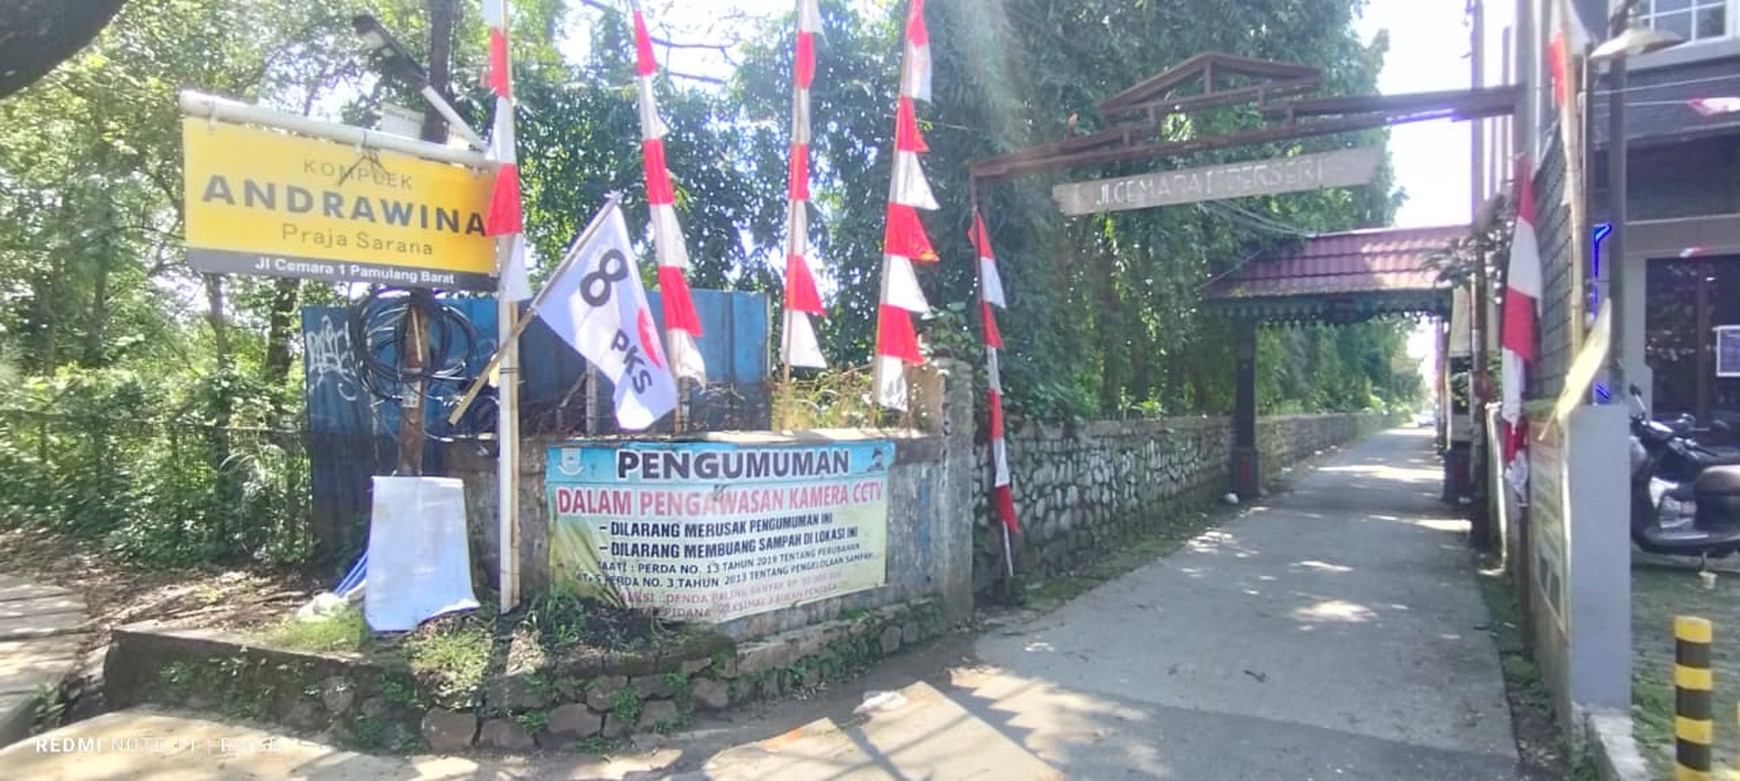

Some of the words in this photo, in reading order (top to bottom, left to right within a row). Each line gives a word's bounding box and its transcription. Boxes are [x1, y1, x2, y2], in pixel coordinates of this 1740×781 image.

[303, 158, 412, 191] KOMPLEK
[202, 174, 487, 237] ANDRAWINA
[282, 222, 348, 249] Praja
[356, 231, 434, 256] Sarana
[275, 258, 334, 275] Cemara
[339, 263, 346, 276] 1
[350, 263, 418, 283] Pamulang
[421, 270, 455, 285] Barat
[579, 248, 629, 308] 8
[610, 328, 653, 396] PKS
[617, 449, 850, 480] PENGUMUMAN
[557, 488, 632, 517] DALAM
[639, 488, 785, 518] PENGAWASAN
[789, 483, 849, 510] KAMERA
[852, 479, 884, 504] CCTV
[611, 521, 680, 538] DILARANG
[684, 520, 747, 538] MERUSAK
[750, 514, 819, 533] PENGUMUMAN
[821, 512, 833, 524] INI
[611, 541, 680, 558] DILARANG
[684, 541, 757, 559] MEMBUANG
[758, 535, 800, 552] SAMPAH
[803, 533, 813, 545] DI
[815, 528, 845, 543] LOKASI
[638, 563, 677, 575] PERDA
[706, 563, 720, 575] 13
[722, 559, 754, 571] TAHUN
[757, 555, 778, 566] 2019
[780, 550, 816, 562] TENTANG
[666, 577, 675, 588] 3
[679, 577, 719, 588] TAHUN
[724, 573, 747, 586] 2013
[750, 565, 790, 580] TENTANG
